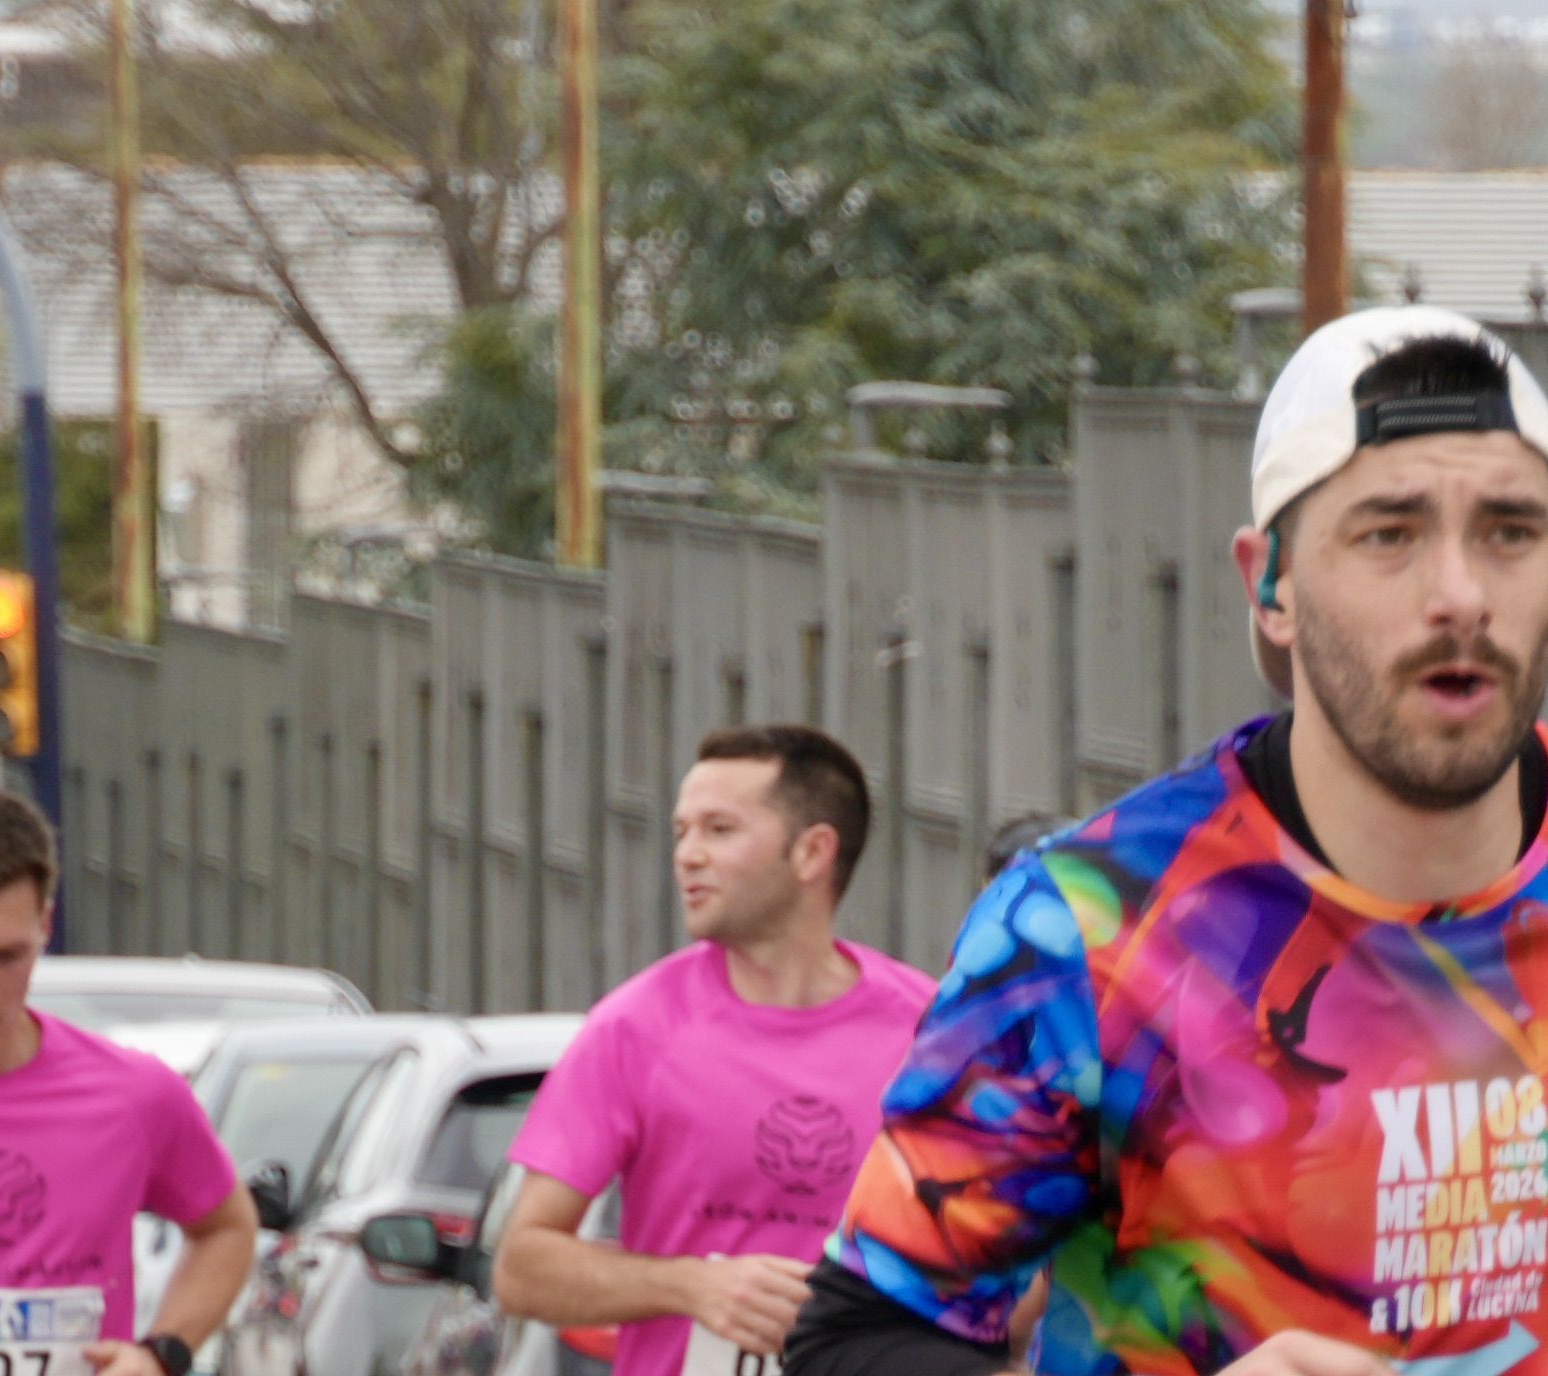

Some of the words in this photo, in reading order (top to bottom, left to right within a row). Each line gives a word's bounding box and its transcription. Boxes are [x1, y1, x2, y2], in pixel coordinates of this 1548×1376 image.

[1371, 1080, 1482, 1184] XII
[1485, 1074, 1547, 1139] 08
[1376, 1176, 1488, 1234] MEDIA
[1491, 1167, 1548, 1204] 2026
[1373, 1209, 1548, 1284] MARATÓN
[1369, 1298, 1388, 1334] &
[1393, 1278, 1463, 1333] 10K
